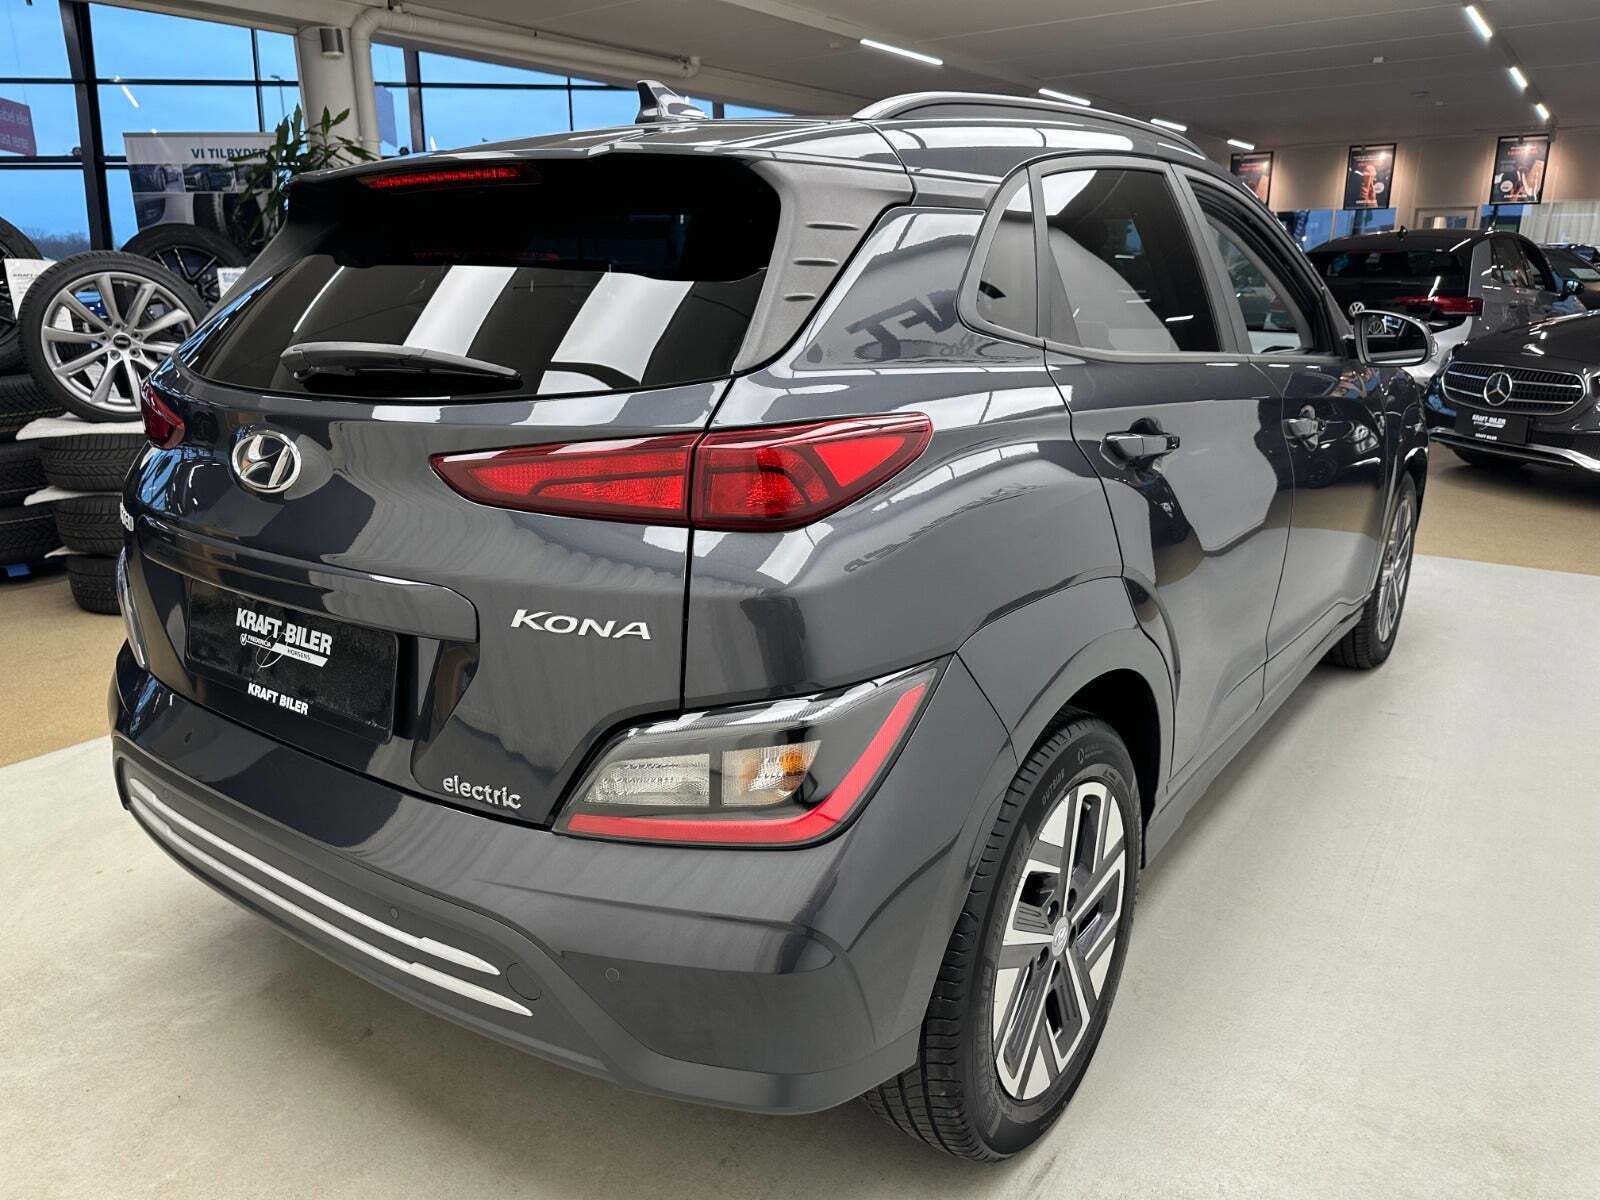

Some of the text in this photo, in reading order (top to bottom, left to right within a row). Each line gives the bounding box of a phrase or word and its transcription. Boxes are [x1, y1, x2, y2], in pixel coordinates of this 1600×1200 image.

[191, 148, 204, 158] VI
[236, 608, 333, 656] KRAFT BILER
[511, 609, 652, 640] KONA
[287, 648, 311, 660] HORSENS
[248, 683, 309, 716] KRAFT BILER
[443, 776, 522, 810] electric
